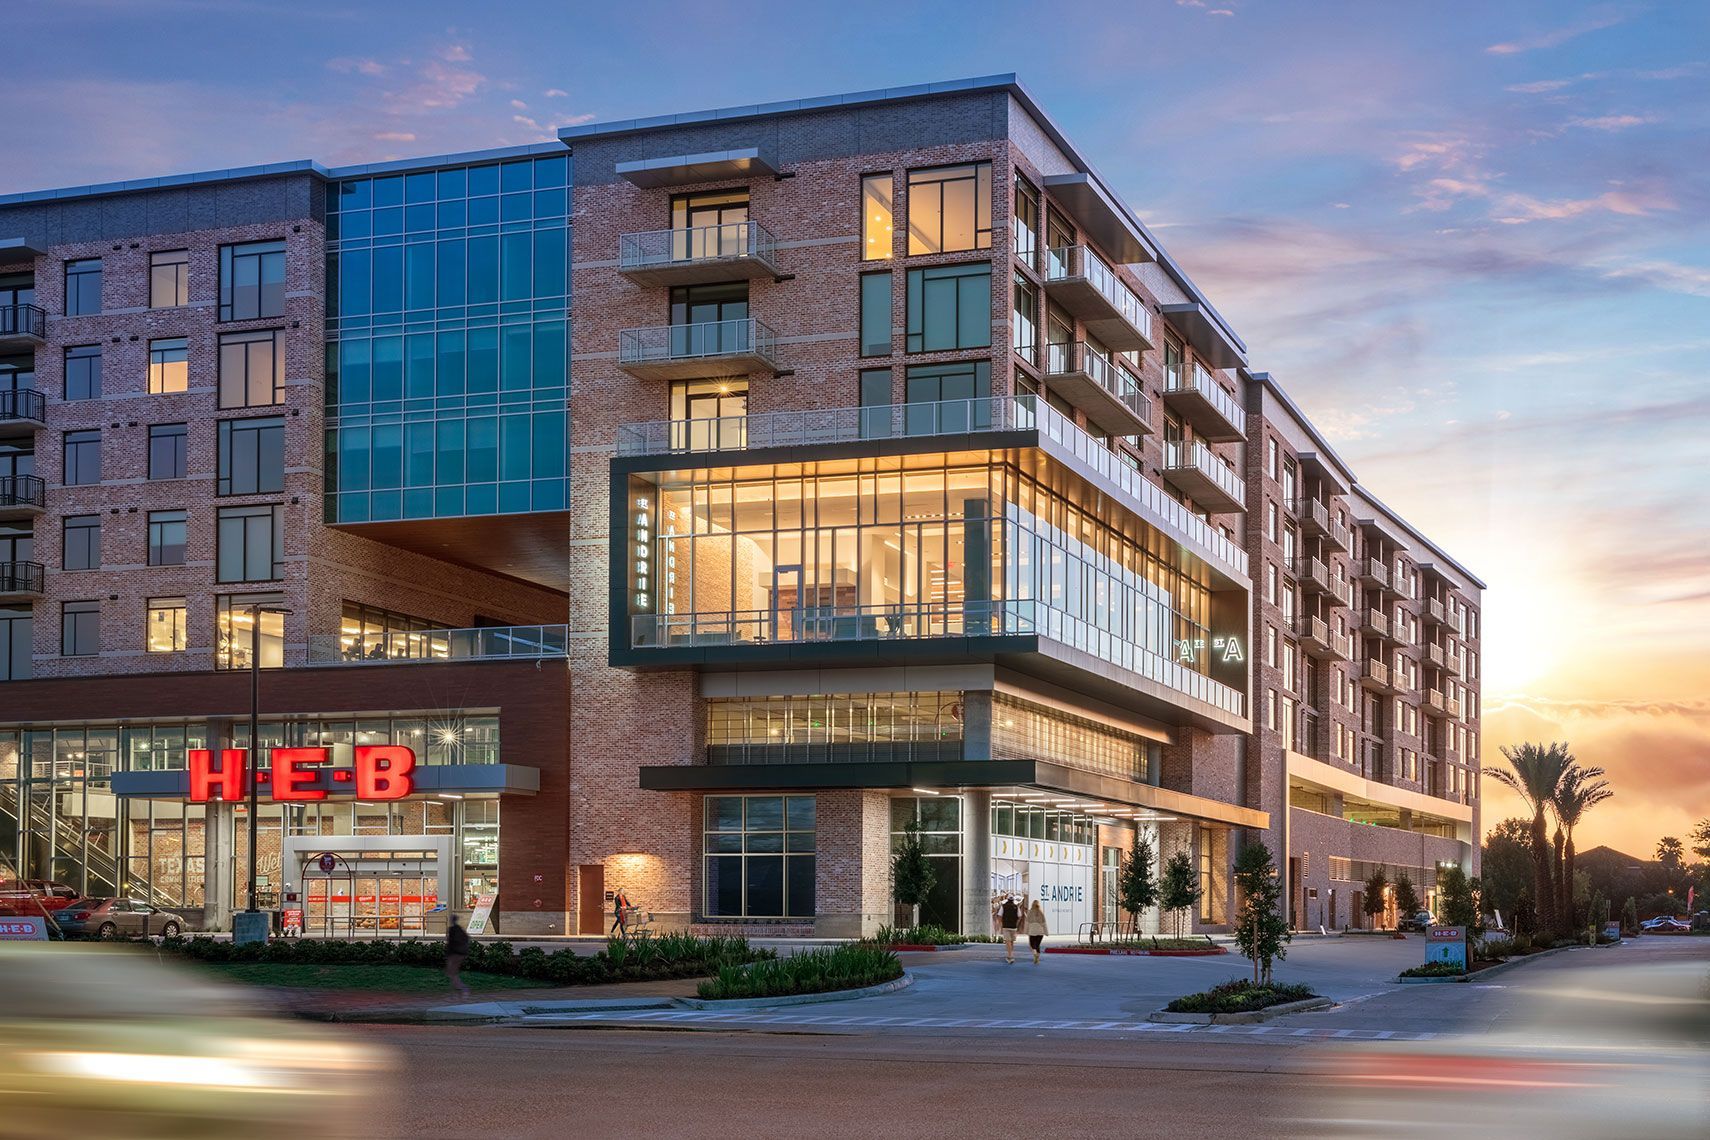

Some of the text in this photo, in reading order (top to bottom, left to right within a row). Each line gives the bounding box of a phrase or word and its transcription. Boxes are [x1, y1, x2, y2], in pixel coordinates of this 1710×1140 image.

[1223, 637, 1243, 662] A
[158, 857, 205, 873] TEXAS
[1051, 885, 1083, 902] ANDRIE
